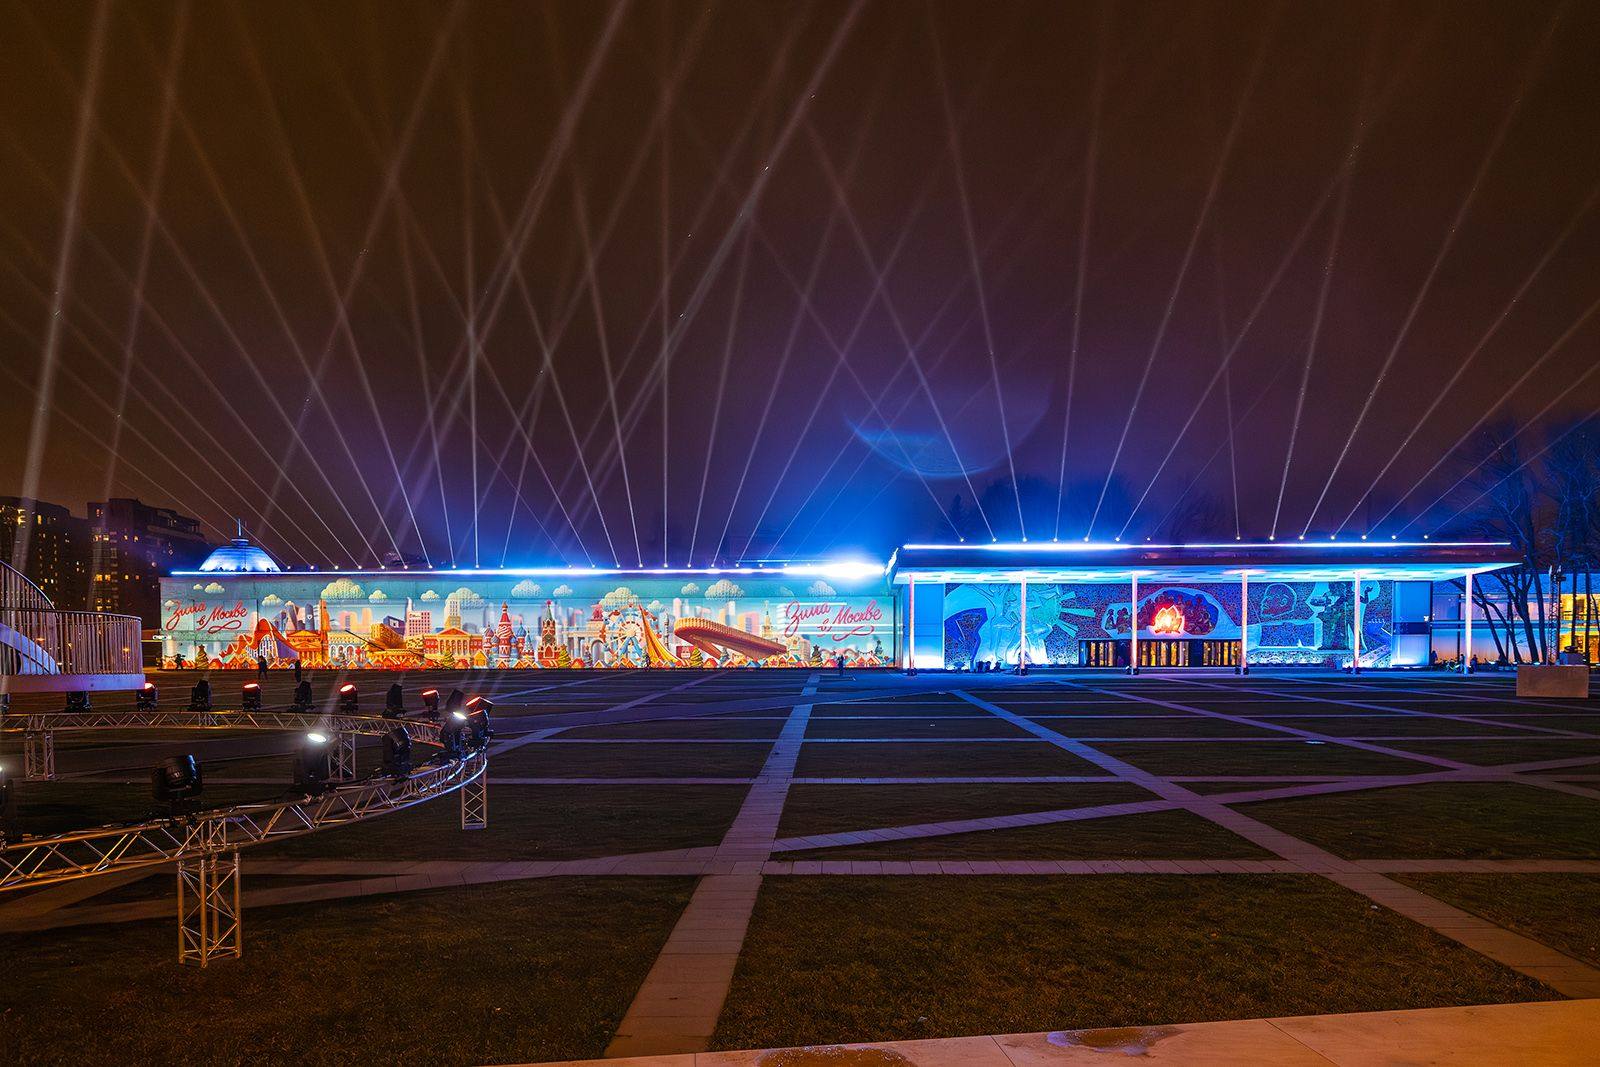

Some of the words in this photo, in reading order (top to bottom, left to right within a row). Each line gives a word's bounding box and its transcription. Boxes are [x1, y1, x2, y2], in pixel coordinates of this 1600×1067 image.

[165, 598, 207, 630] Зима
[196, 599, 248, 630] Москве
[784, 601, 830, 637] Зима
[817, 600, 882, 637] Москве
